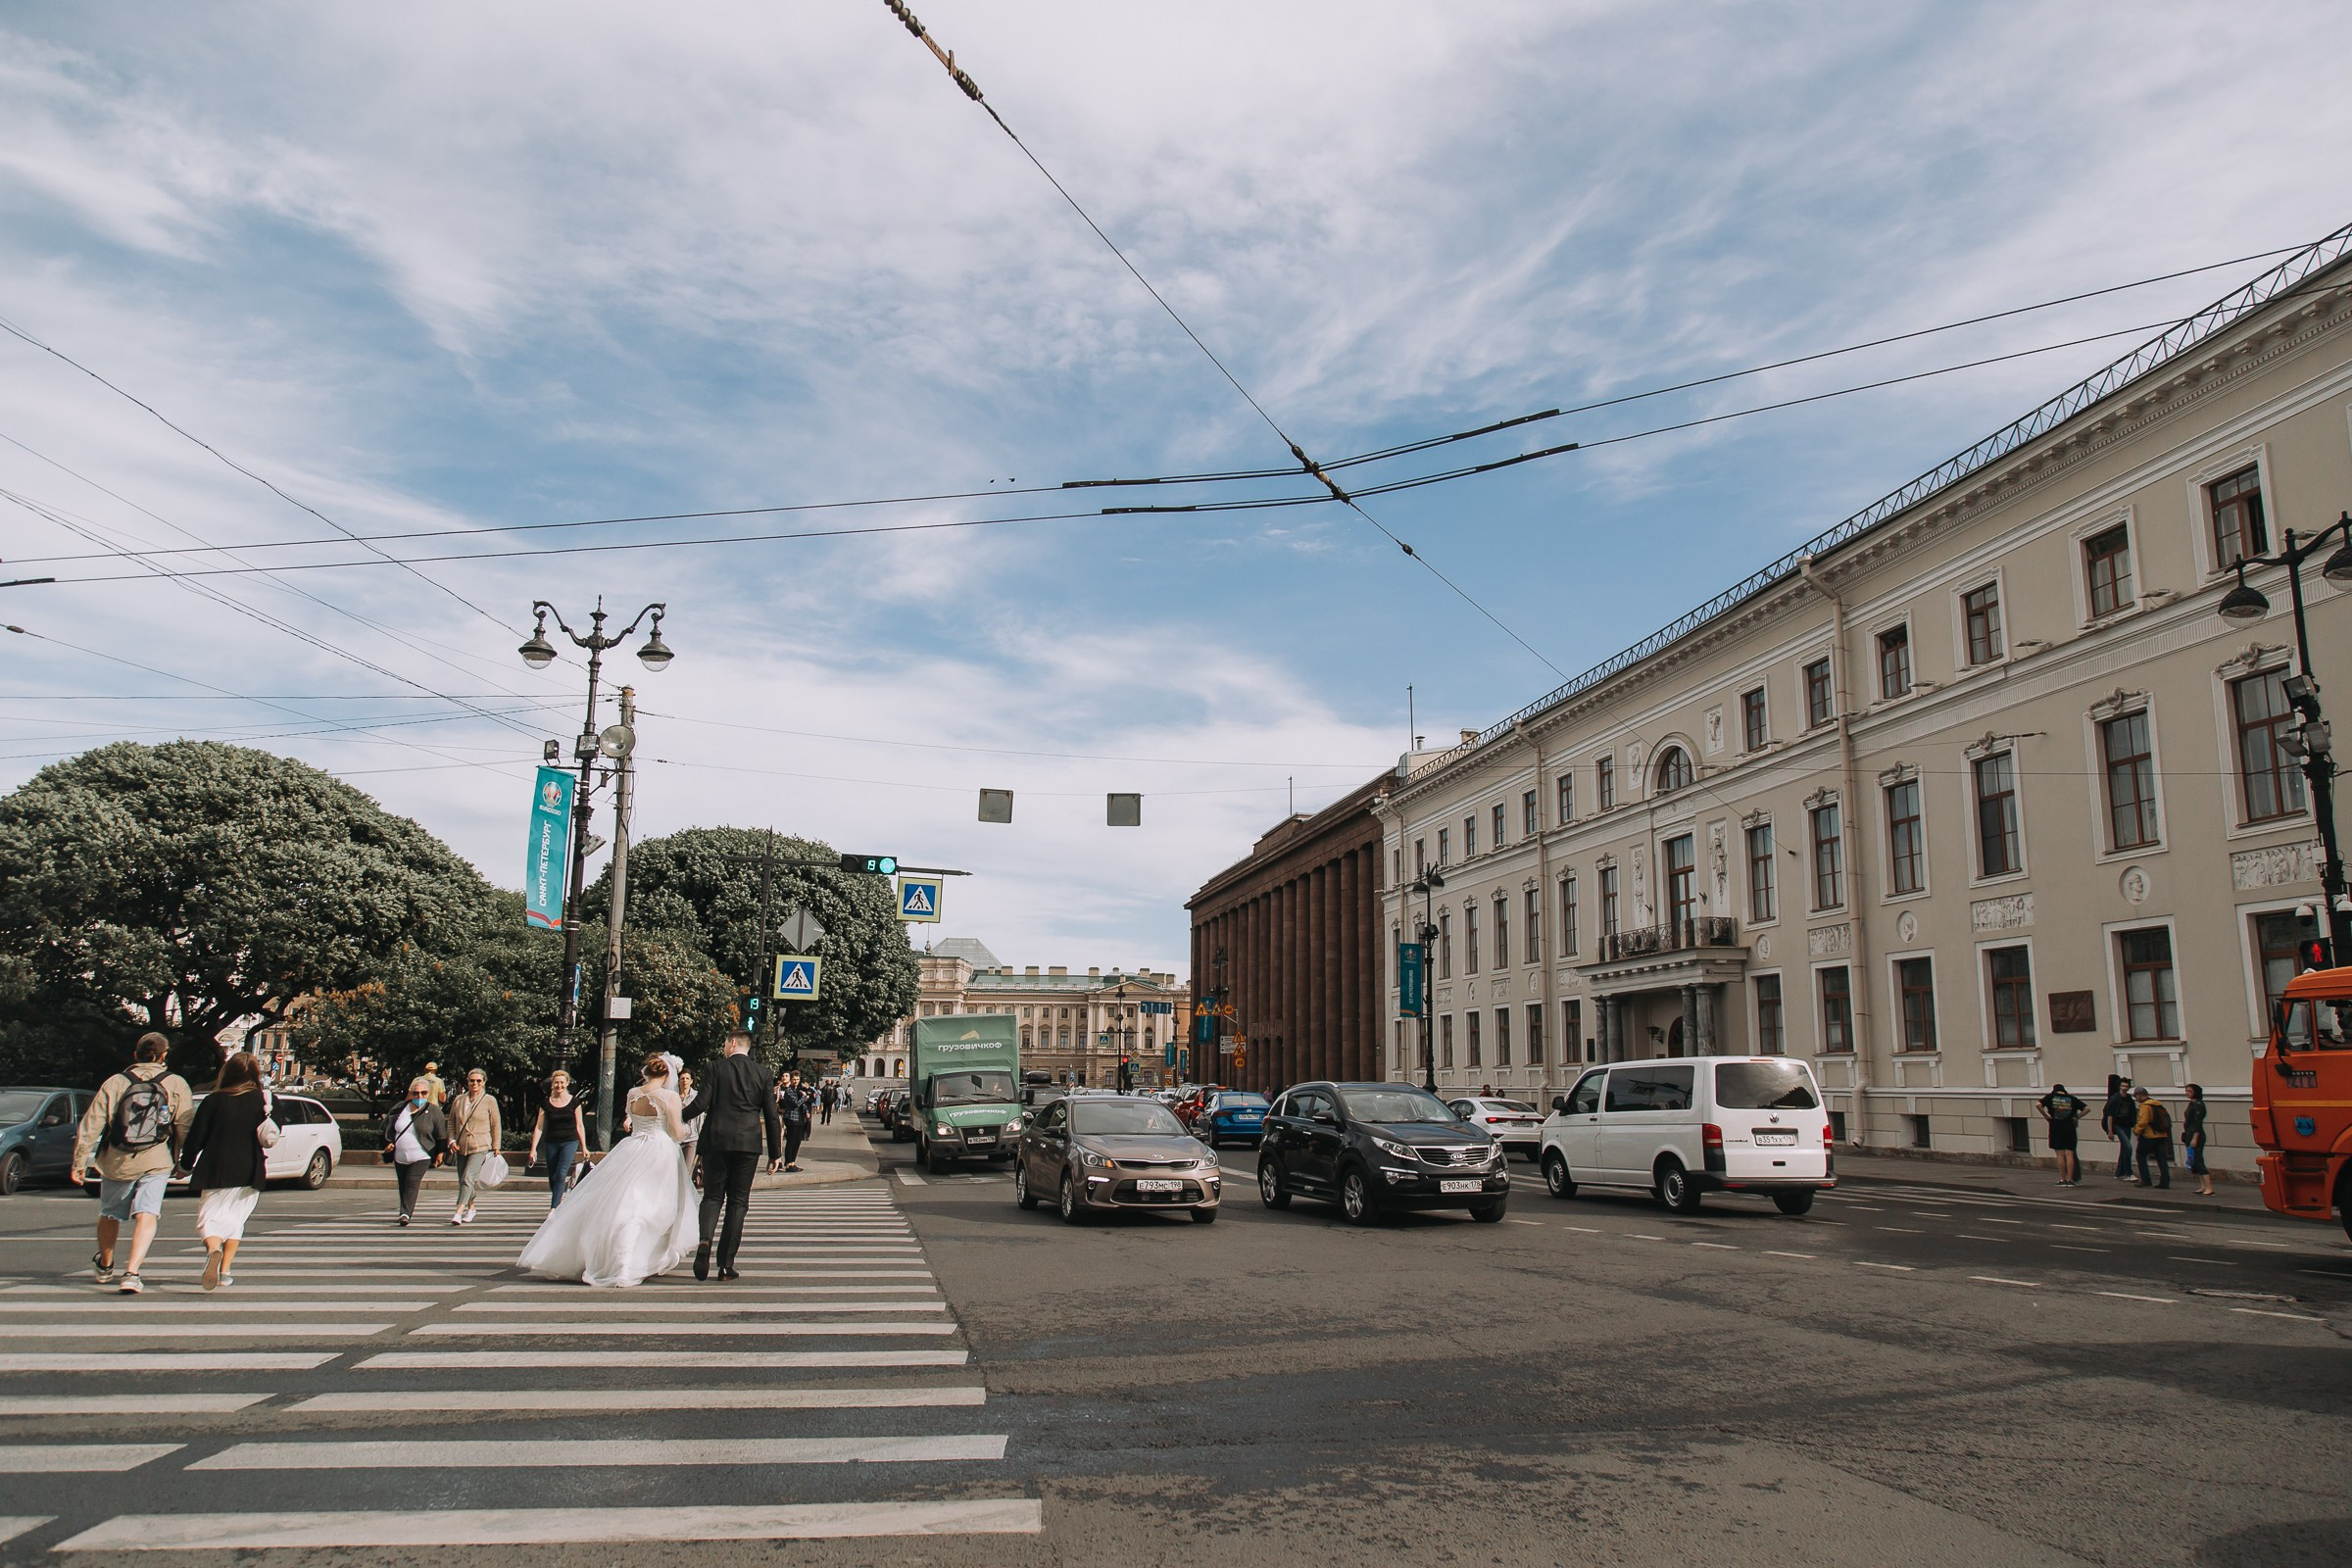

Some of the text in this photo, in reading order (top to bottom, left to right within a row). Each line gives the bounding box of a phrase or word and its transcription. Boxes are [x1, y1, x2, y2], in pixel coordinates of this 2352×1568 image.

[539, 819, 552, 907] САНКТ-ПЕТЕРБУРГ
[750, 998, 760, 1009] 19
[938, 1041, 1003, 1053] грузовичкоф
[949, 1108, 1007, 1117] грузовичкоф
